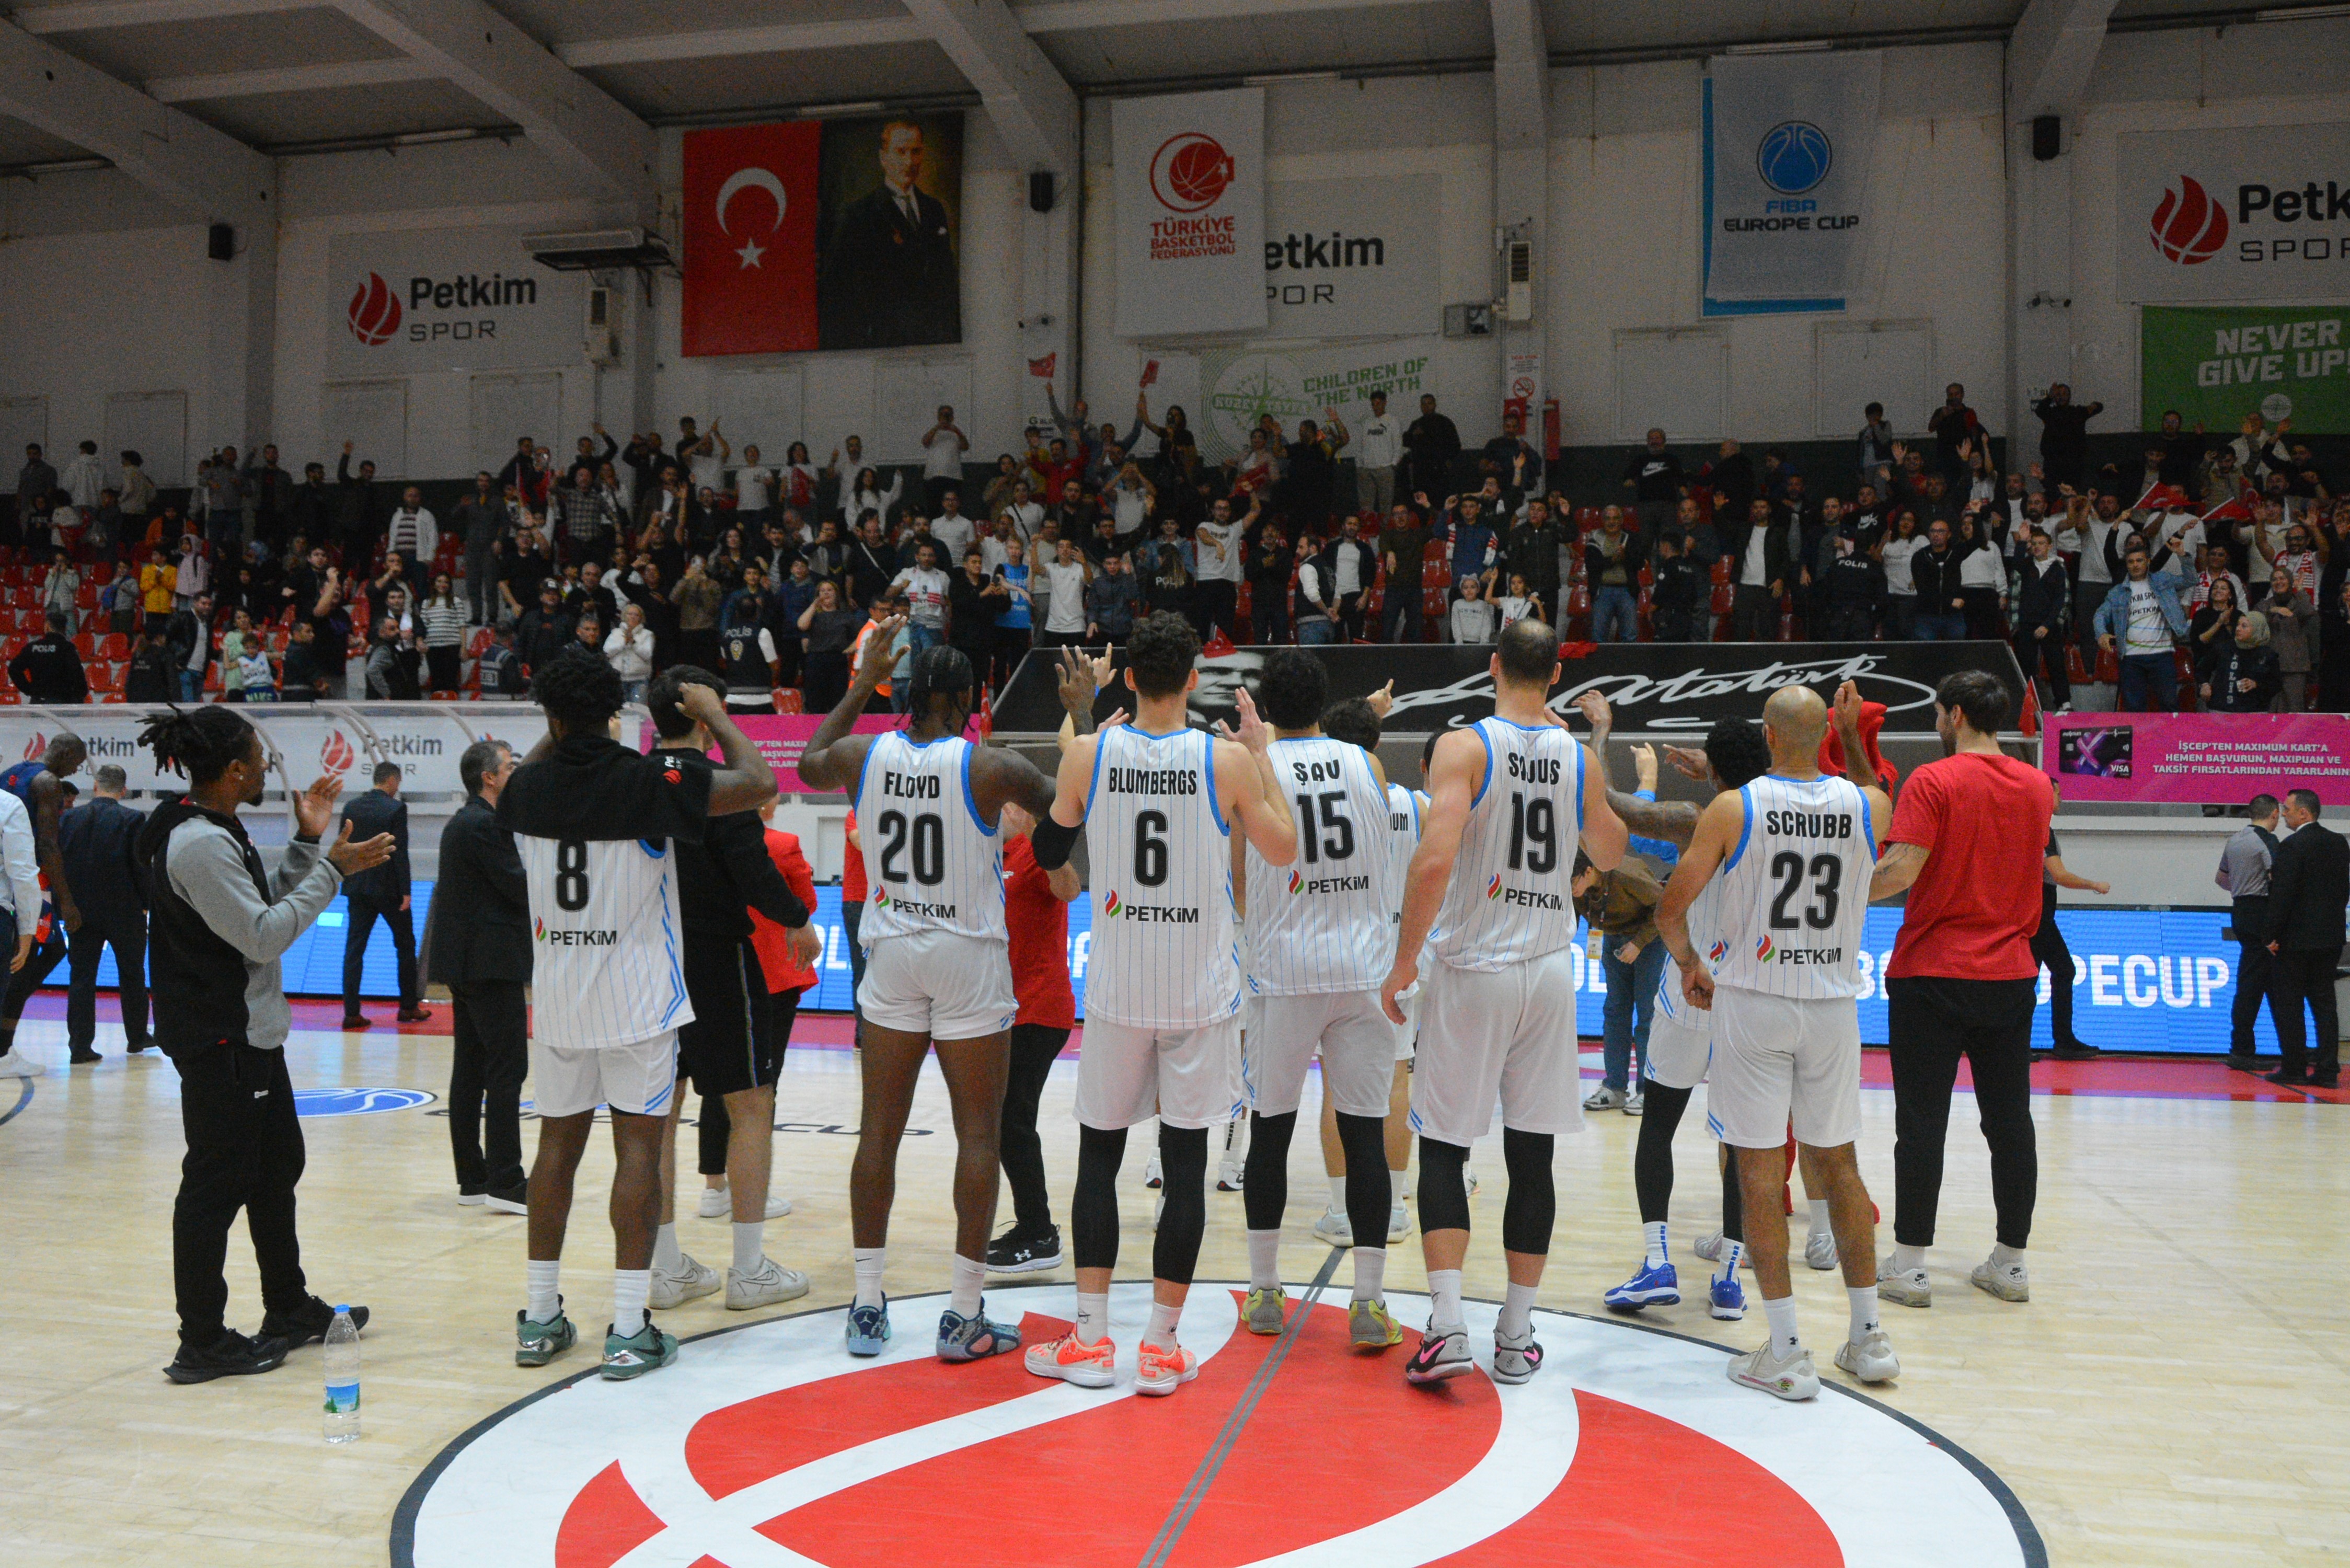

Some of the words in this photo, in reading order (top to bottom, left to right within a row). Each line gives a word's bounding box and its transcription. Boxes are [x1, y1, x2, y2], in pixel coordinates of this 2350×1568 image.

[1766, 200, 1817, 213] FIBA
[1150, 214, 1235, 236] TÜRKİYE
[1724, 217, 1810, 232] EUROPE
[1817, 215, 1859, 229] CUP
[1151, 233, 1235, 249] BASKETBOL
[1151, 245, 1236, 259] FEDERASYONU
[1265, 232, 1384, 270] etkim
[410, 273, 537, 310] Petkim
[1266, 284, 1334, 304] POR
[410, 320, 497, 342] SPOR
[2215, 319, 2342, 355] NEVER
[1303, 363, 1398, 394] CHILDREN
[1403, 356, 1429, 375] OF
[2197, 354, 2284, 387] GIVE
[2297, 348, 2350, 378] UP
[1314, 388, 1351, 407] THE
[1357, 376, 1421, 399] NORTH
[86, 736, 134, 757] tkim
[2165, 753, 2203, 763] HEMEN
[2206, 754, 2267, 764] BAŞVURUN,
[2270, 755, 2324, 764] MAXIPUAN
[2235, 743, 2288, 752] MAXIMUM
[2291, 744, 2329, 752] KART'A
[1109, 767, 1197, 795] BLUMBERGS
[1293, 759, 1340, 786] ŞAV
[2110, 764, 2129, 773] VISA
[2153, 763, 2188, 774] TAKSİT
[2192, 765, 2281, 774] FIRSATLARINDAN
[2283, 767, 2350, 776] YARARLANIN
[884, 771, 940, 799] FLOYD
[1296, 790, 1355, 864] 15
[1507, 791, 1557, 875] 19
[1766, 810, 1852, 839] SCRUBB
[878, 809, 944, 886] 20
[1134, 809, 1169, 887] 6
[556, 838, 590, 912] 8
[1769, 850, 1842, 930] 23
